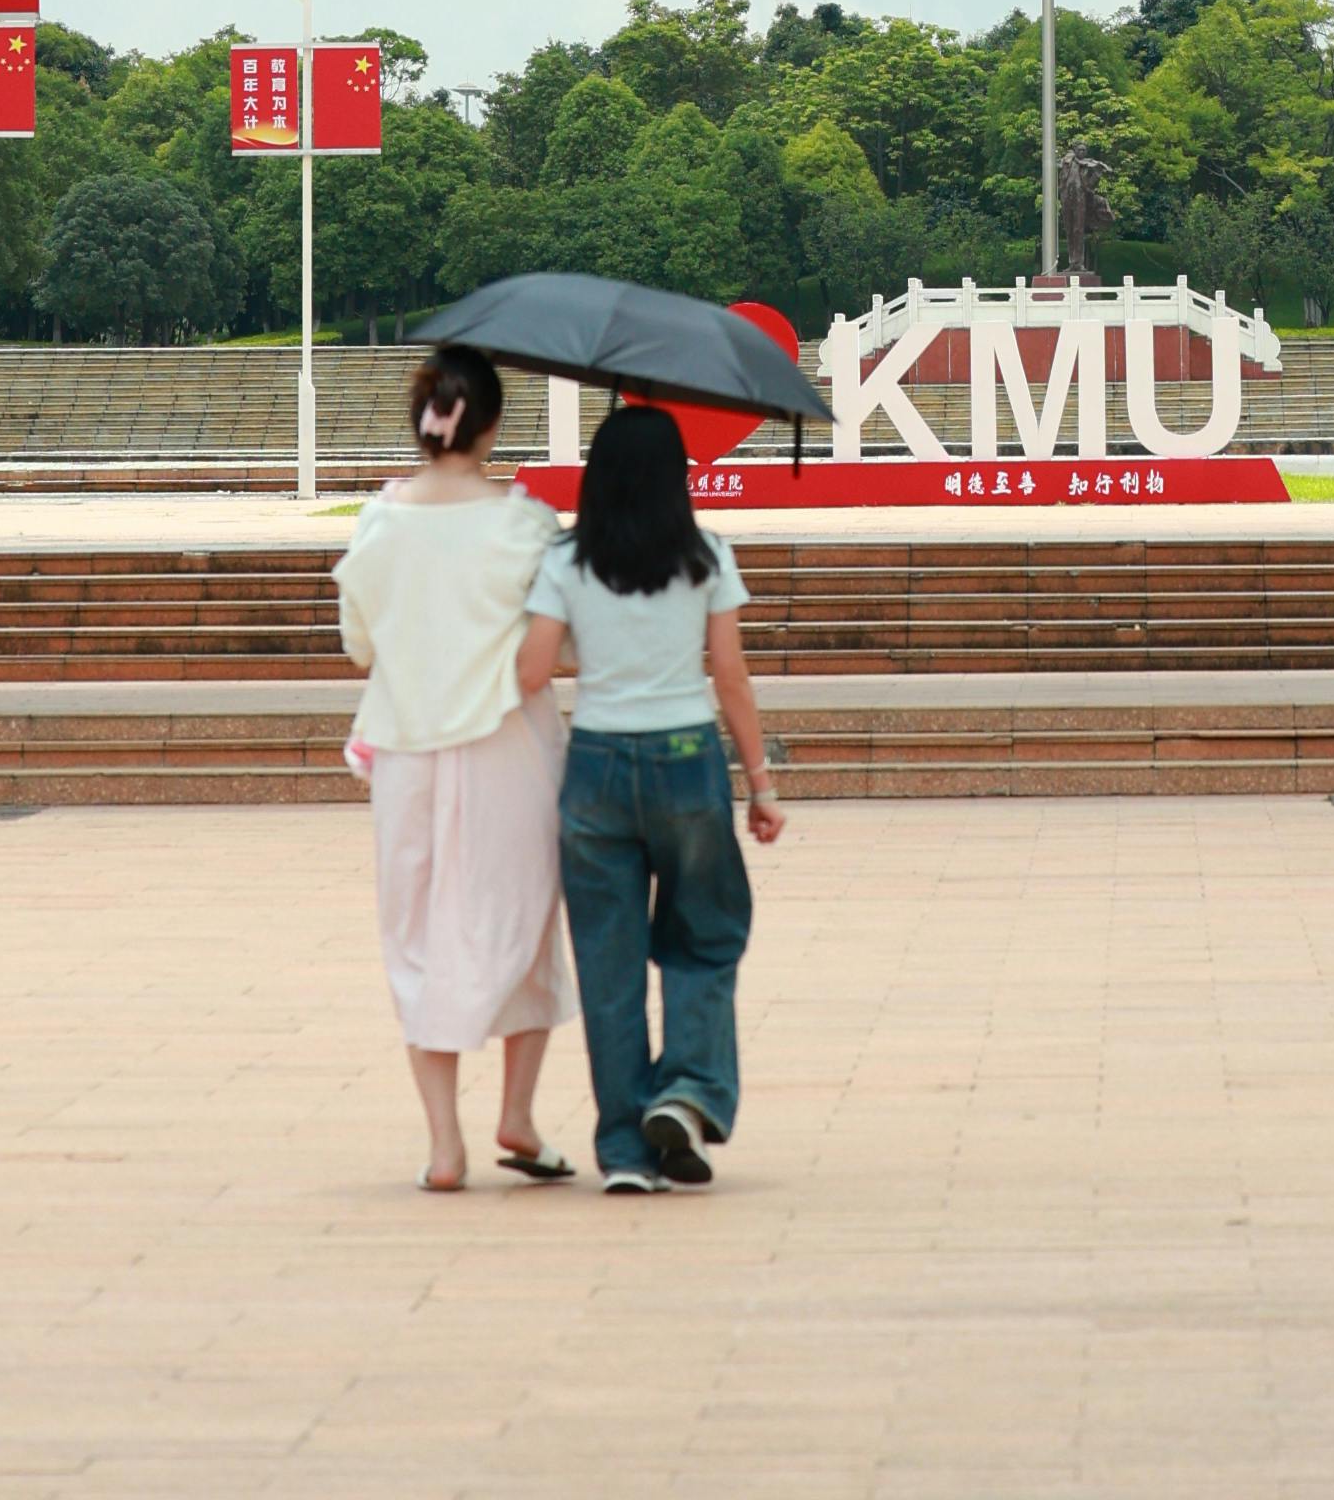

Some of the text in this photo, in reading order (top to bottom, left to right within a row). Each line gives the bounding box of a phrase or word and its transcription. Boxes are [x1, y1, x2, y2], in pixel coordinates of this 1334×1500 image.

[243, 58, 259, 131] 百年大计
[271, 58, 287, 130] 教育为本
[833, 316, 1243, 465] KMU
[945, 468, 1165, 496] 明德至善 知行利物
